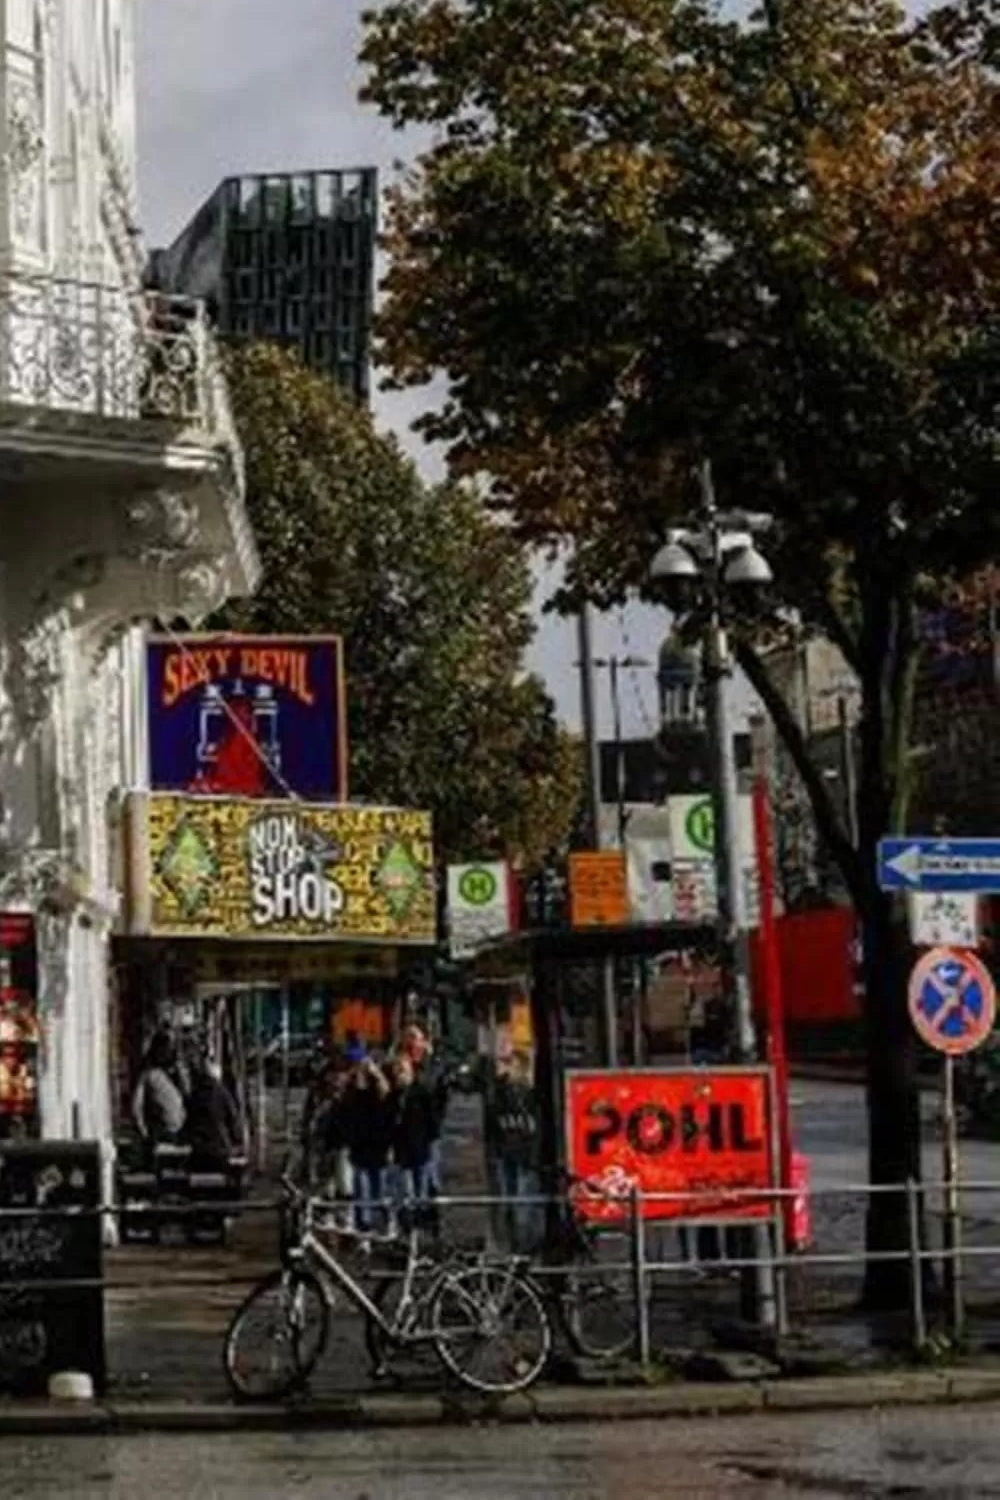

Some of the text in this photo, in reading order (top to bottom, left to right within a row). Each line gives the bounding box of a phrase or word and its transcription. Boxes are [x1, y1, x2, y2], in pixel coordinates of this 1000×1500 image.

[162, 648, 315, 706] SEXY DEVIL
[252, 845, 306, 879] STOP
[253, 872, 343, 925] SHOP
[586, 1101, 764, 1155] POHL
